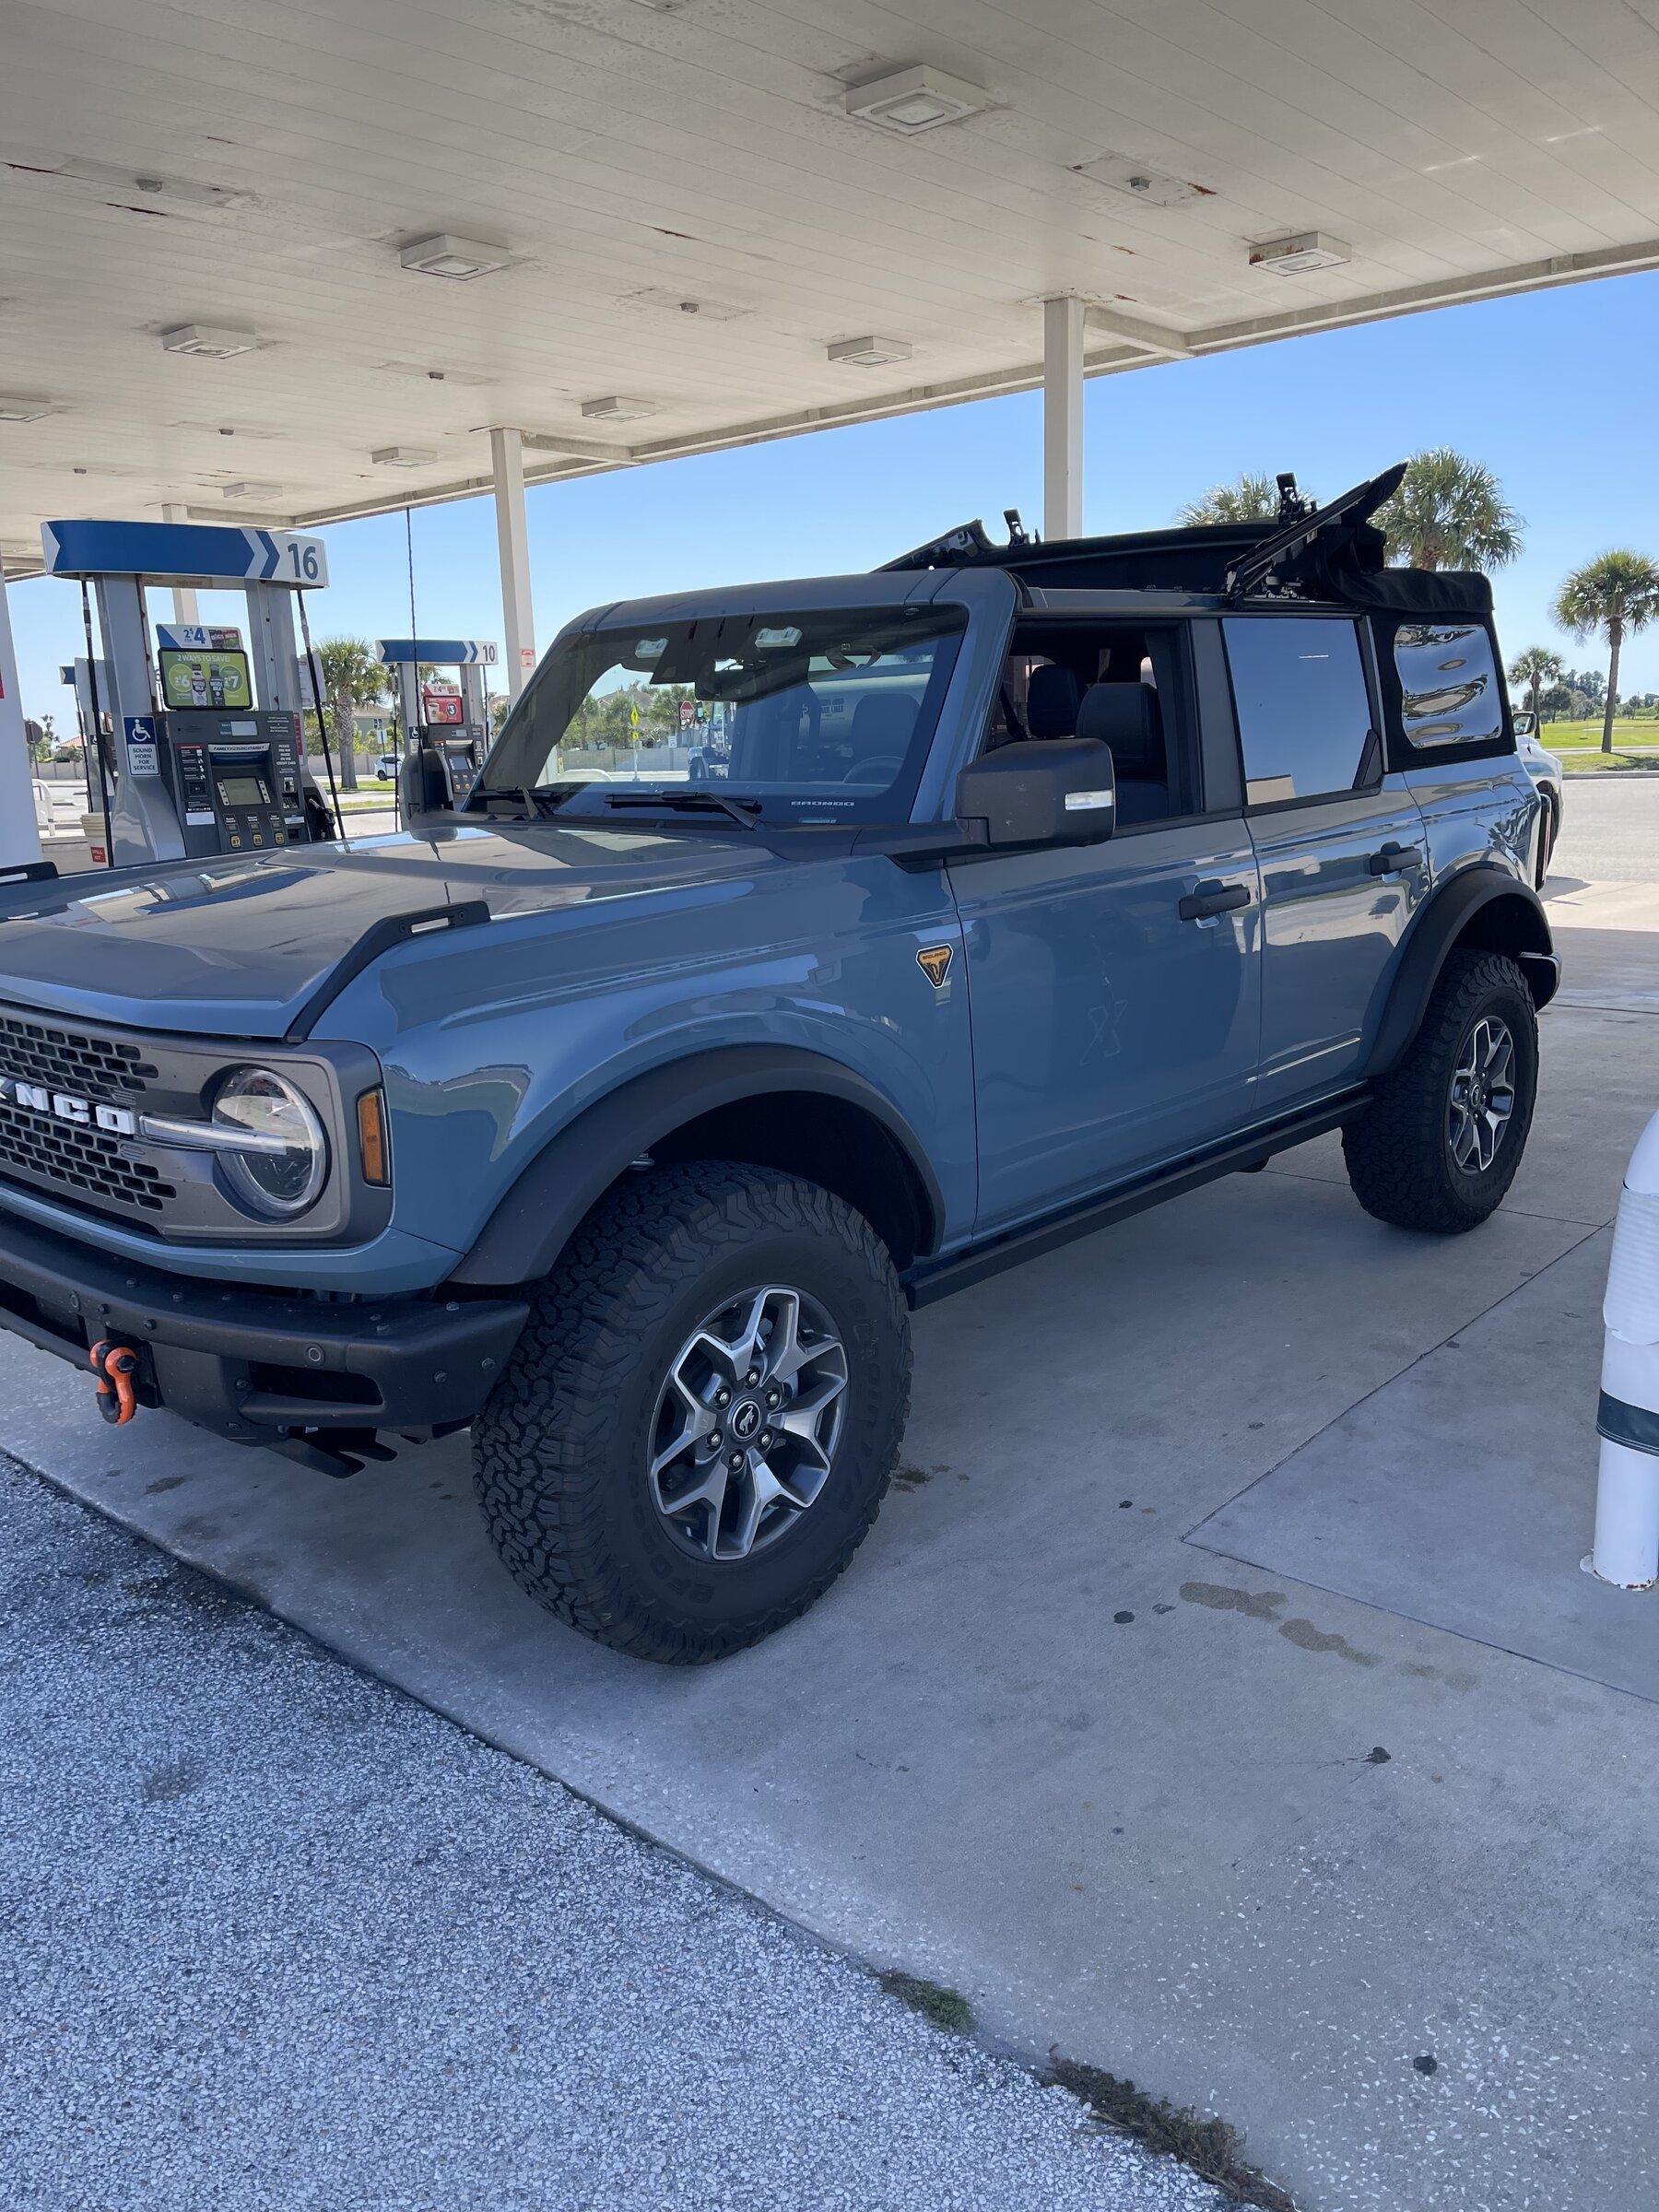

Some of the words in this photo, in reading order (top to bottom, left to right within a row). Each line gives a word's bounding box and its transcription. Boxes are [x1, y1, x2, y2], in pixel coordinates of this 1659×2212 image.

[287, 543, 319, 580] 16
[482, 645, 496, 662] 10
[682, 709, 693, 719] STOP
[0, 1075, 135, 1135] NCO
